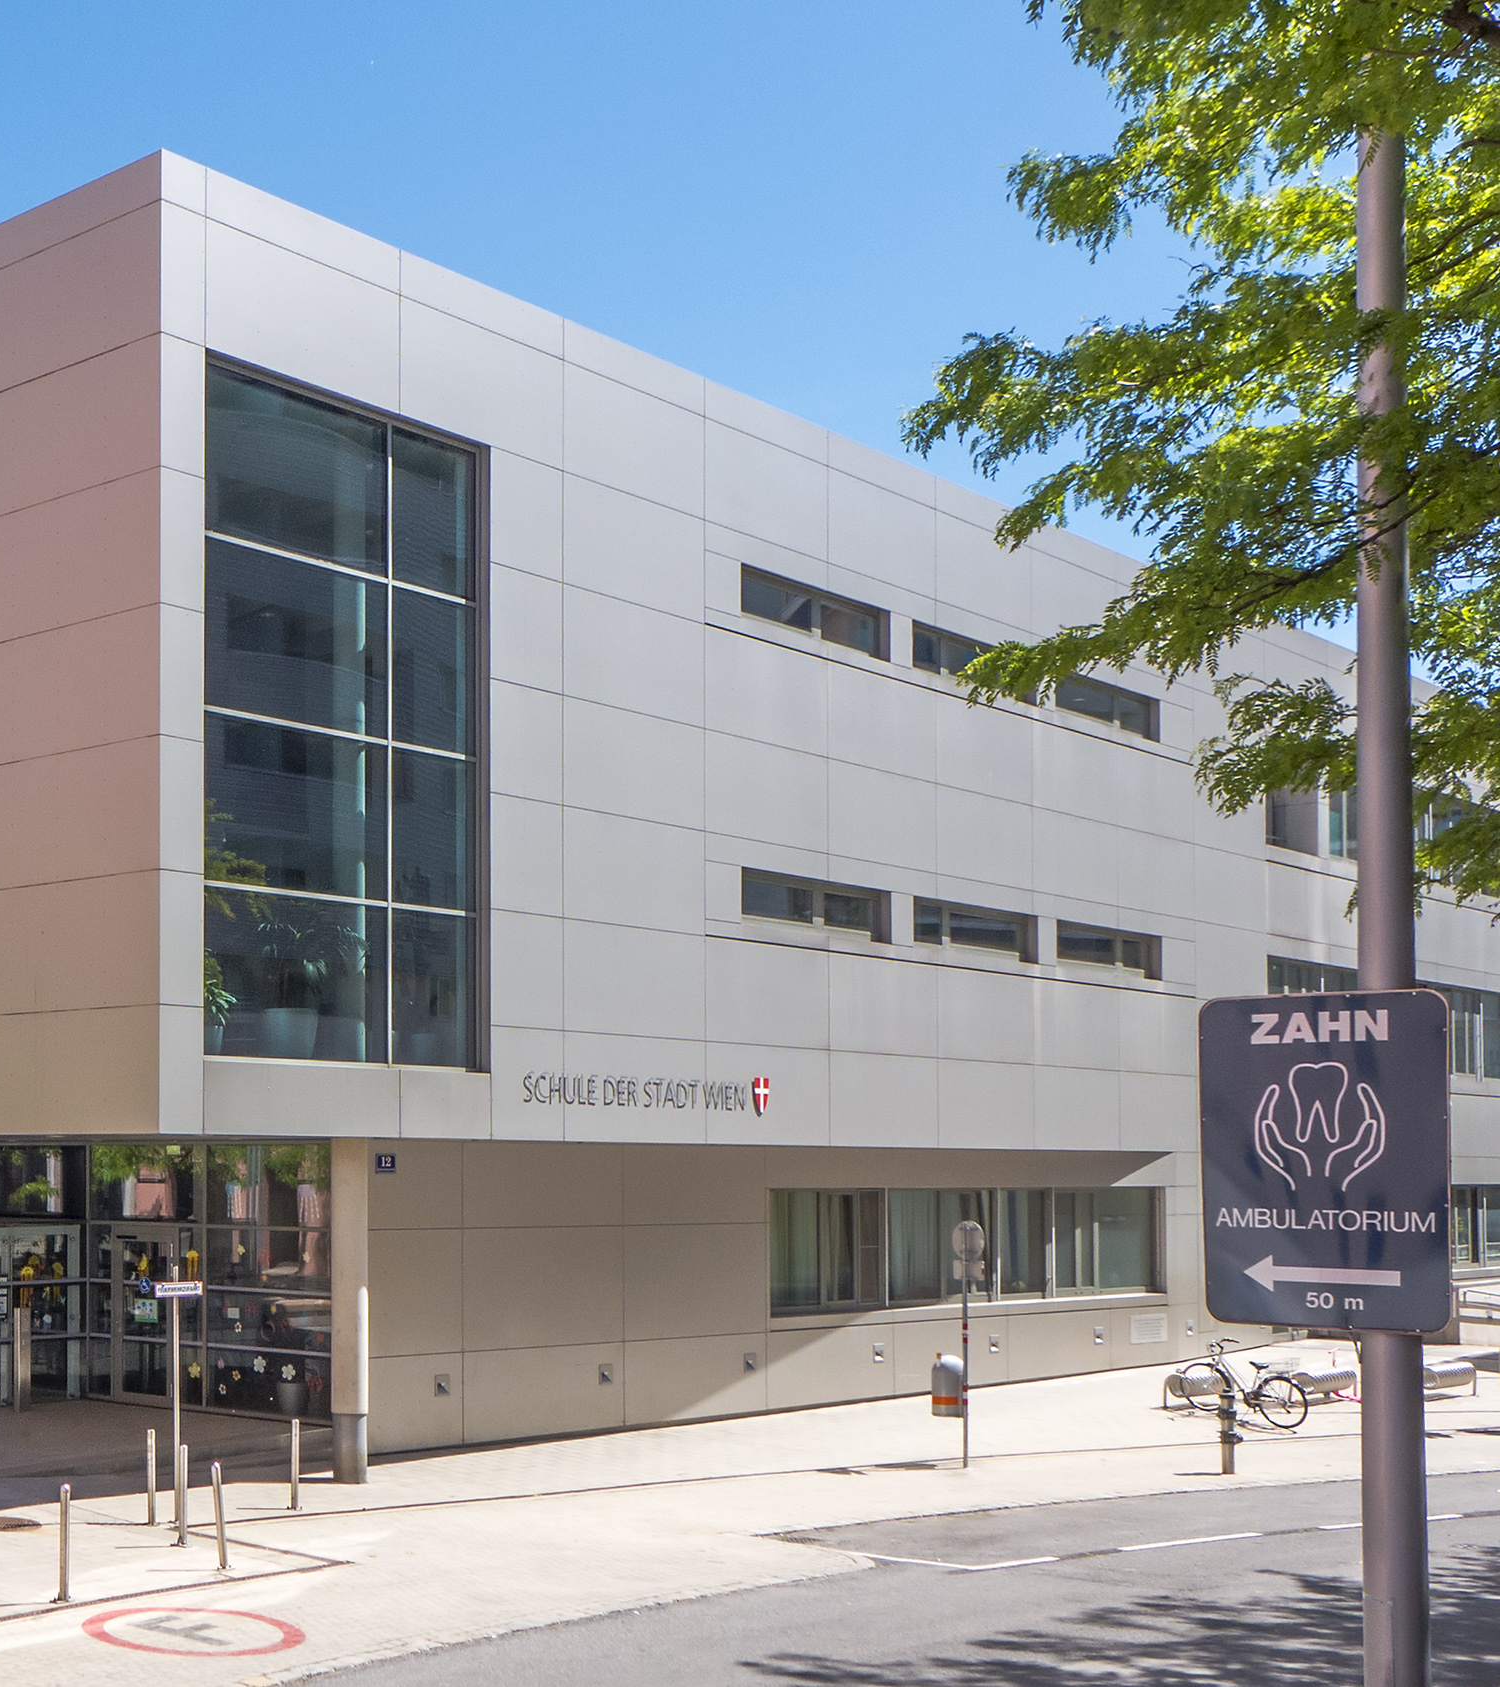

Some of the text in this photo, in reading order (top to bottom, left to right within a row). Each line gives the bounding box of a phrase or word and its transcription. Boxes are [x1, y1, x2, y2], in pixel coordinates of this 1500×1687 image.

[1251, 1009, 1389, 1045] ZAHN
[522, 1071, 747, 1111] SCHULE DER STADT WIEN
[381, 1156, 391, 1167] 12
[1215, 1207, 1437, 1234] AMBULATORIUM
[1305, 1292, 1364, 1311] 50 m
[127, 1615, 234, 1646] F
